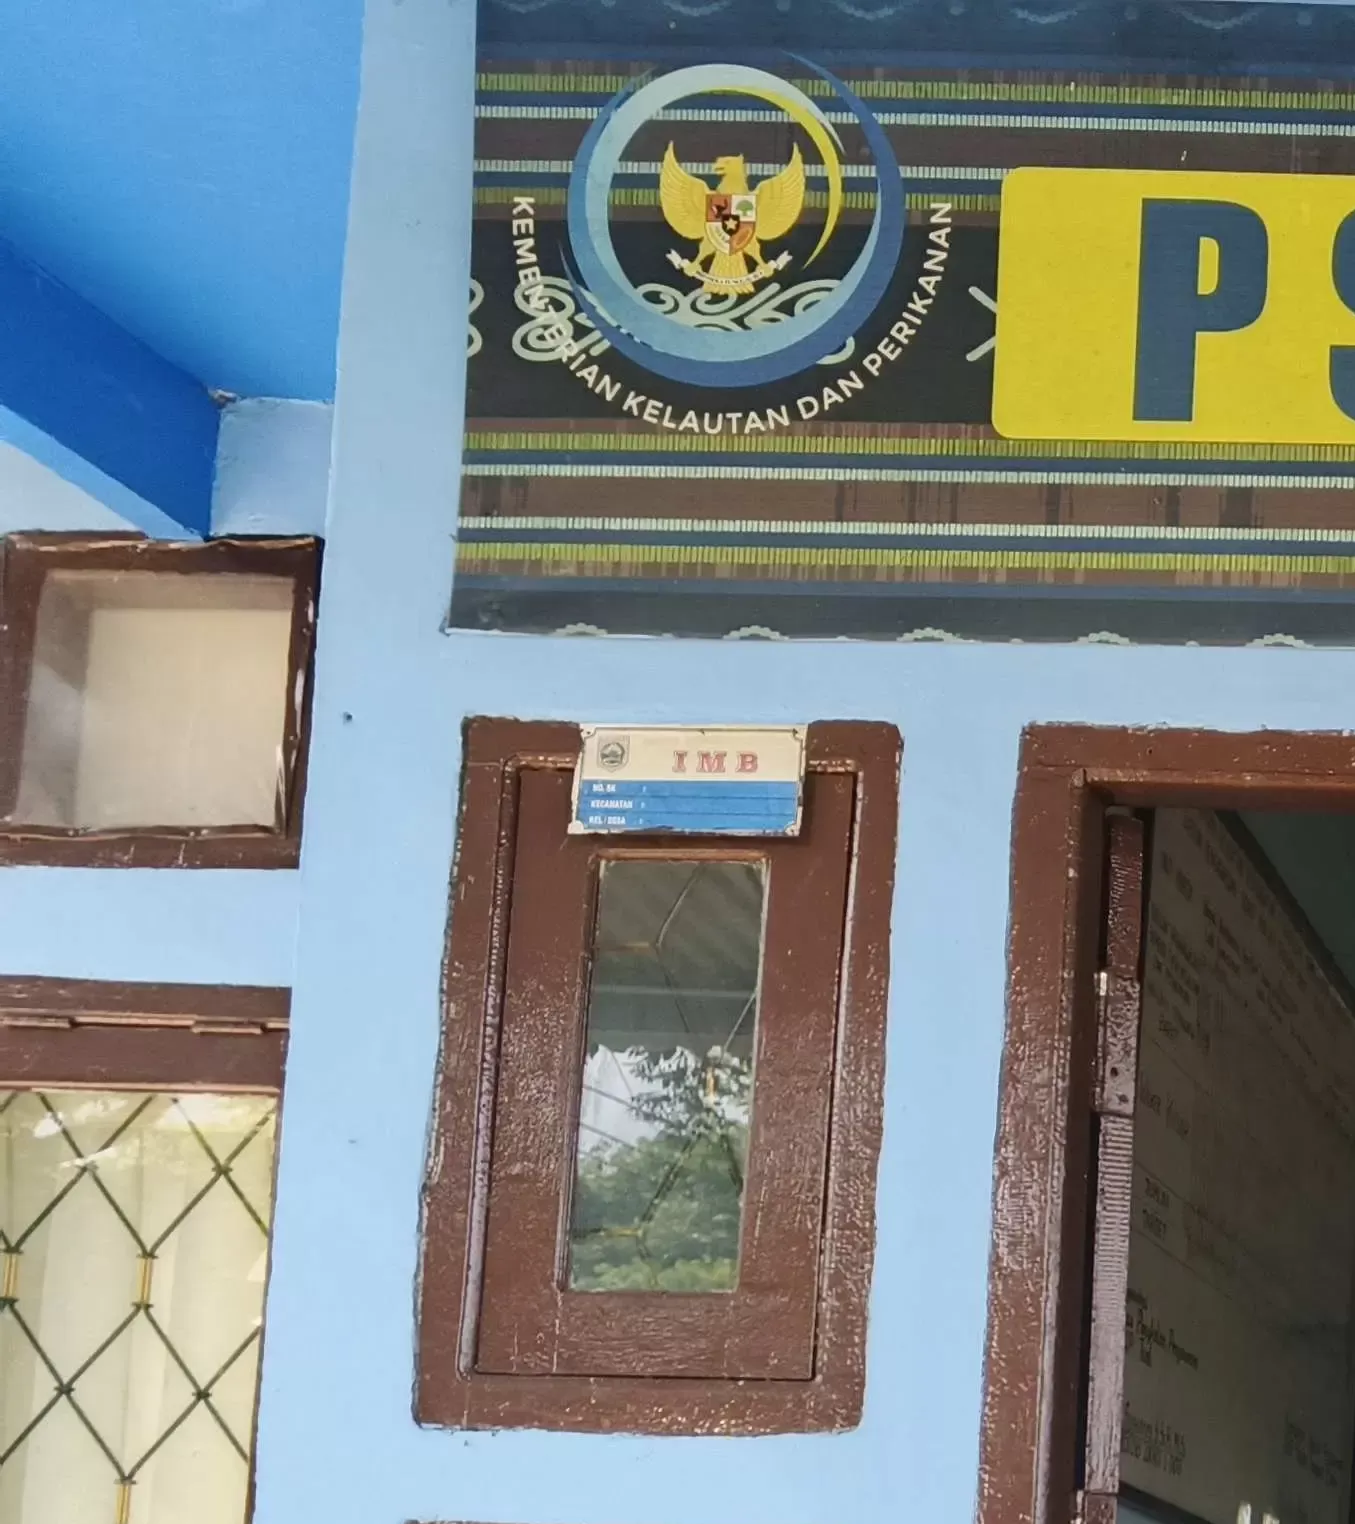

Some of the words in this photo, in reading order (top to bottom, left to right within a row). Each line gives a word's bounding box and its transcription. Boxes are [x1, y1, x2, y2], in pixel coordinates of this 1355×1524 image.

[511, 196, 620, 404] KEMENTERIAN
[621, 390, 791, 435] KELAUTAN
[797, 369, 866, 421] DAN
[864, 201, 953, 378] PERIKANAN
